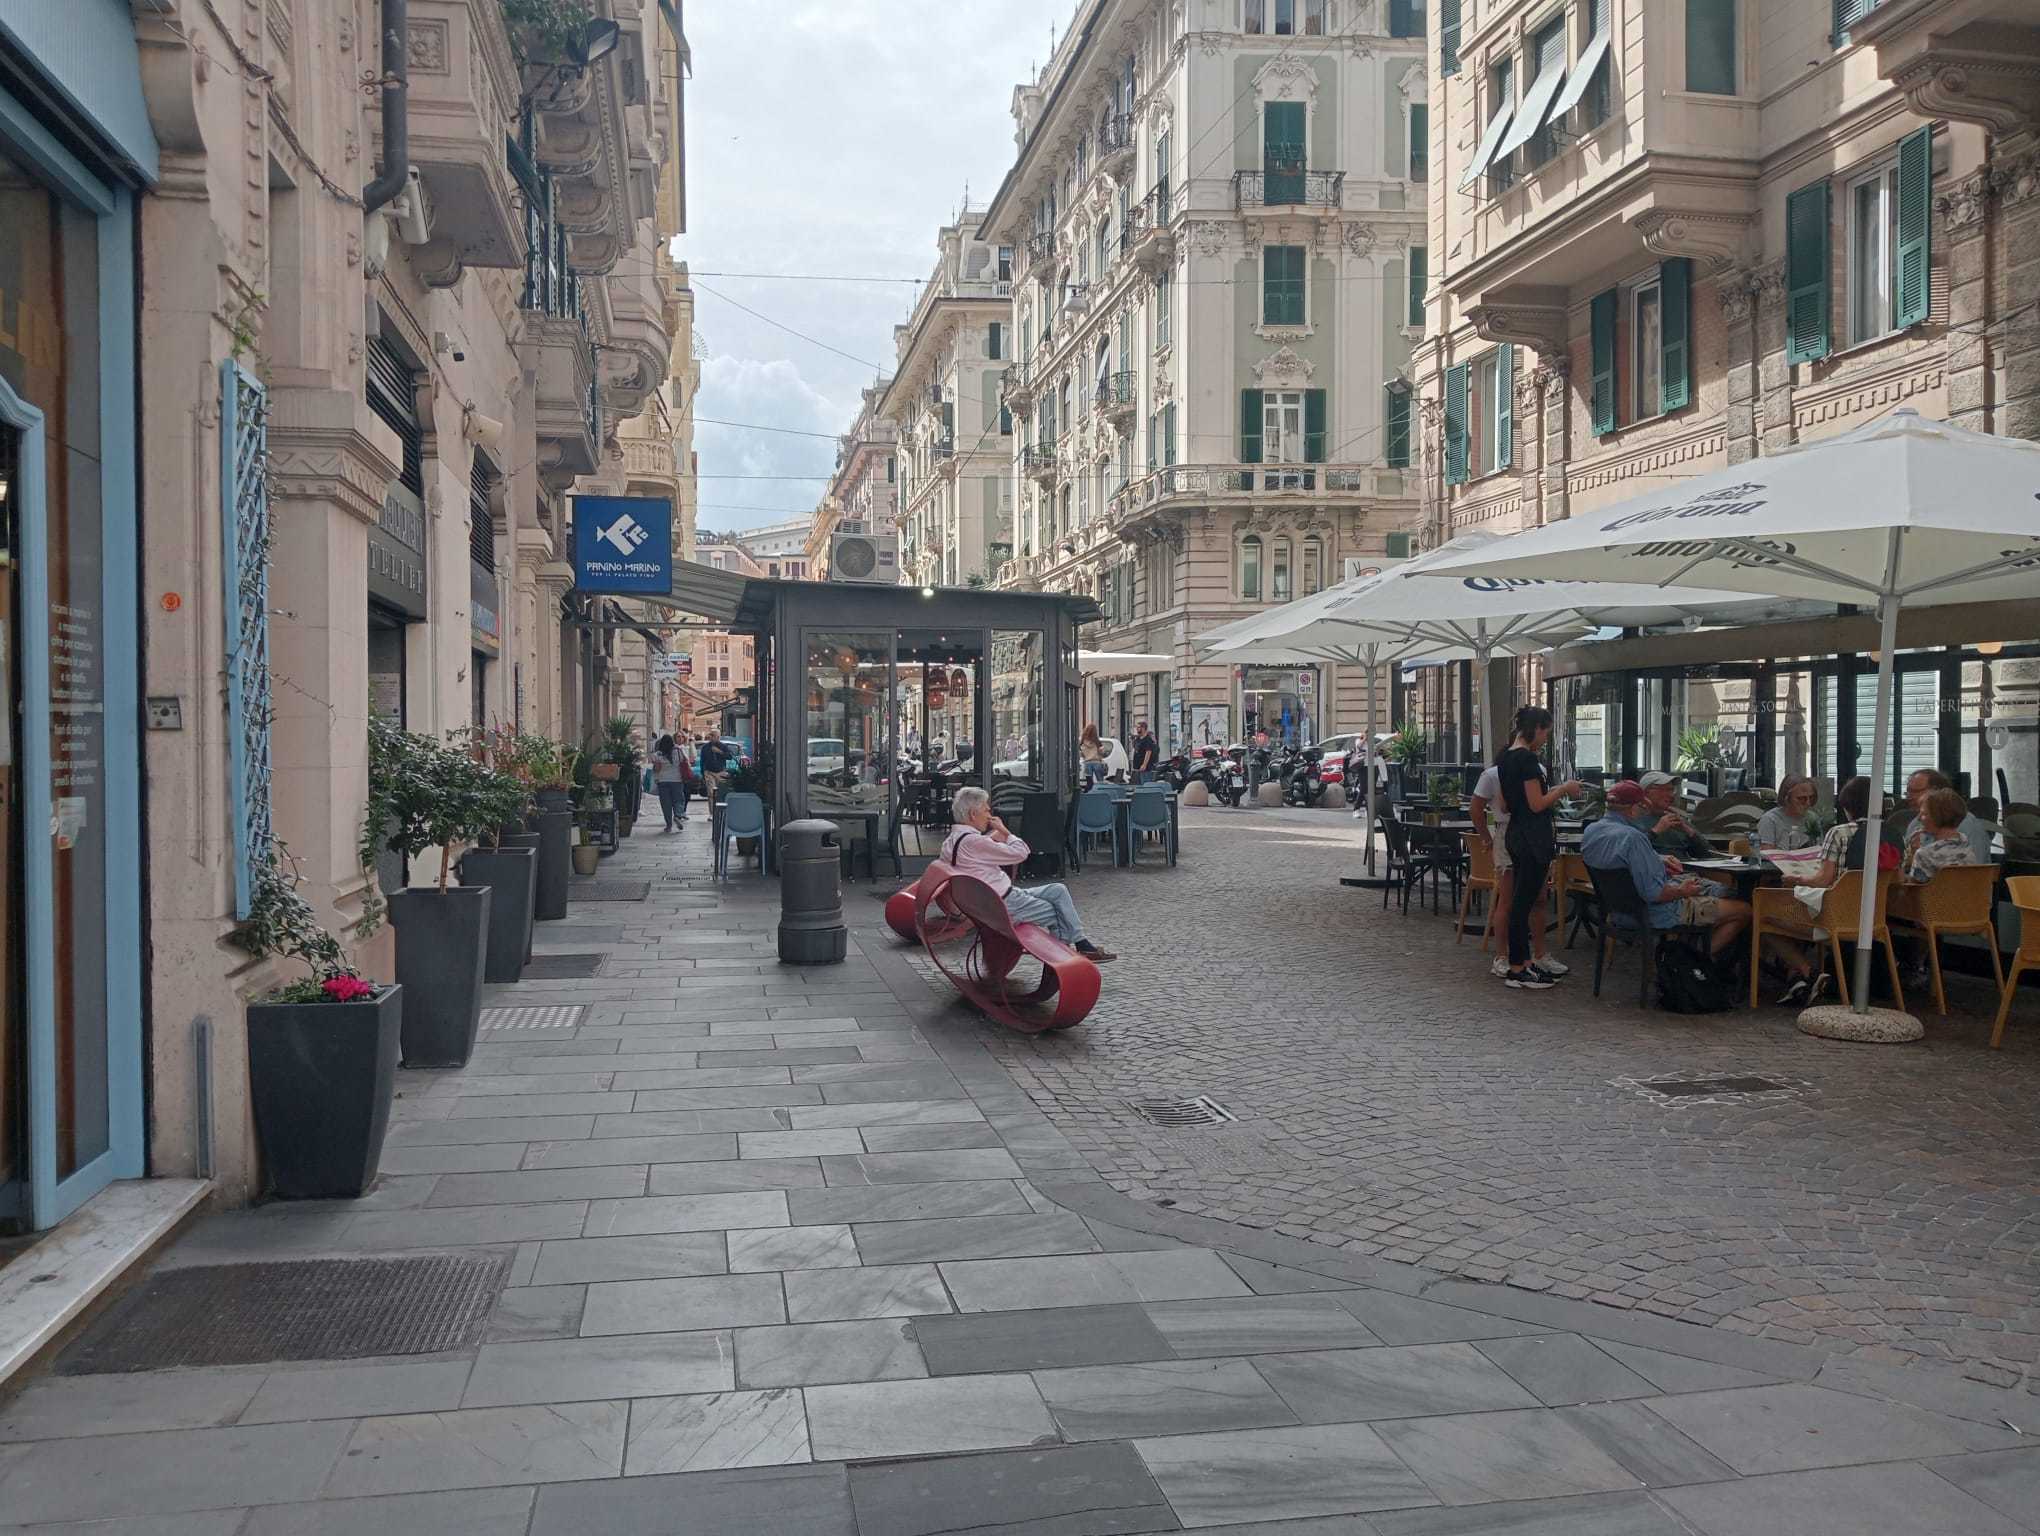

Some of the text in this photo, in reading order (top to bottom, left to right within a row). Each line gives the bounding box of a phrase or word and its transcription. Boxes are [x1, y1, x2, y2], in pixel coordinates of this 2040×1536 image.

[1599, 500, 1769, 532] Corona
[586, 561, 661, 573] PANINO MARINO
